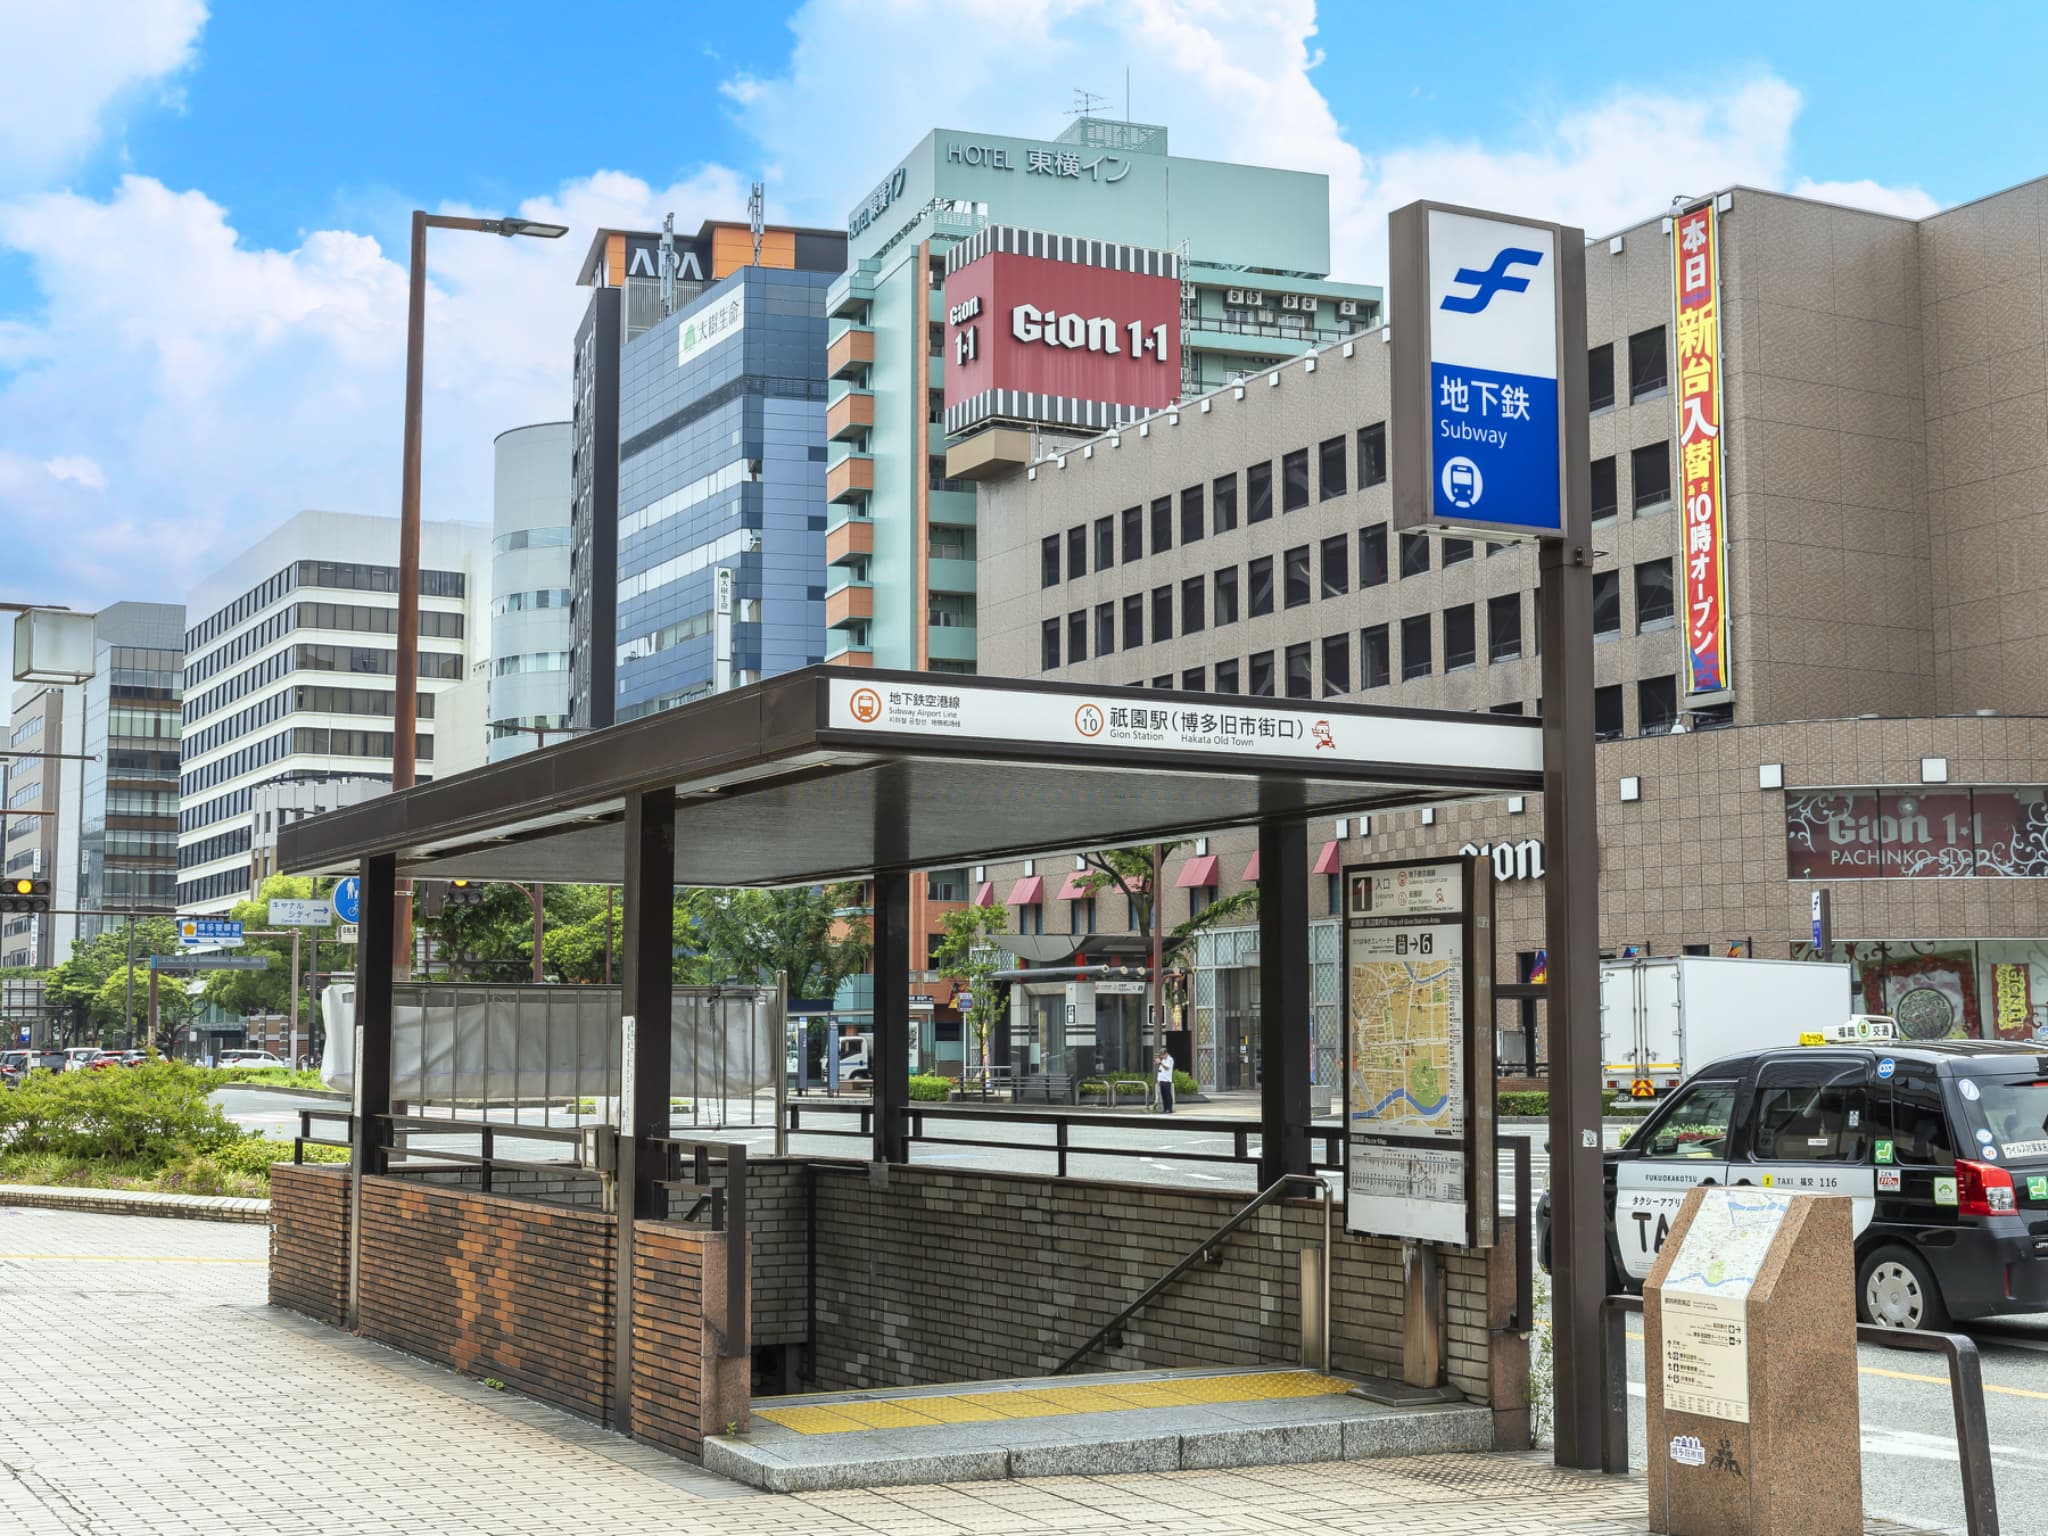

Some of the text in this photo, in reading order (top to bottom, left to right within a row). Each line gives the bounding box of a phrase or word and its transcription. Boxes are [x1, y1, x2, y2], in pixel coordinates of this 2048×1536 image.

[947, 144, 1131, 183] HOTEL 東横イン
[950, 296, 981, 327] Gion
[696, 300, 740, 343] 大樹生命
[1010, 303, 1121, 355] Gion
[1440, 375, 1530, 421] 地下鉄
[1440, 419, 1508, 449] Subway
[889, 691, 960, 710] 地下鉄空港線
[889, 706, 958, 719] Subway Airport Line
[1086, 708, 1093, 718] K
[1082, 718, 1099, 732] 10
[1110, 729, 1164, 741] Gion Station
[1181, 733, 1254, 747] Hakata Old Town
[1829, 815, 1933, 845] Gion
[1459, 840, 1546, 882] on
[1831, 849, 1930, 866] PACHINKO
[1375, 878, 1391, 890] 入口
[1358, 879, 1366, 910] 1
[272, 901, 305, 910] キャナル
[288, 910, 311, 918] シティ
[1422, 934, 1431, 952] 6
[1873, 1024, 1889, 1037] 交通
[1645, 1174, 1698, 1183] FUKUOKAKOTSU
[1776, 1177, 1794, 1185] TAXI
[1820, 1177, 1838, 1188] 116
